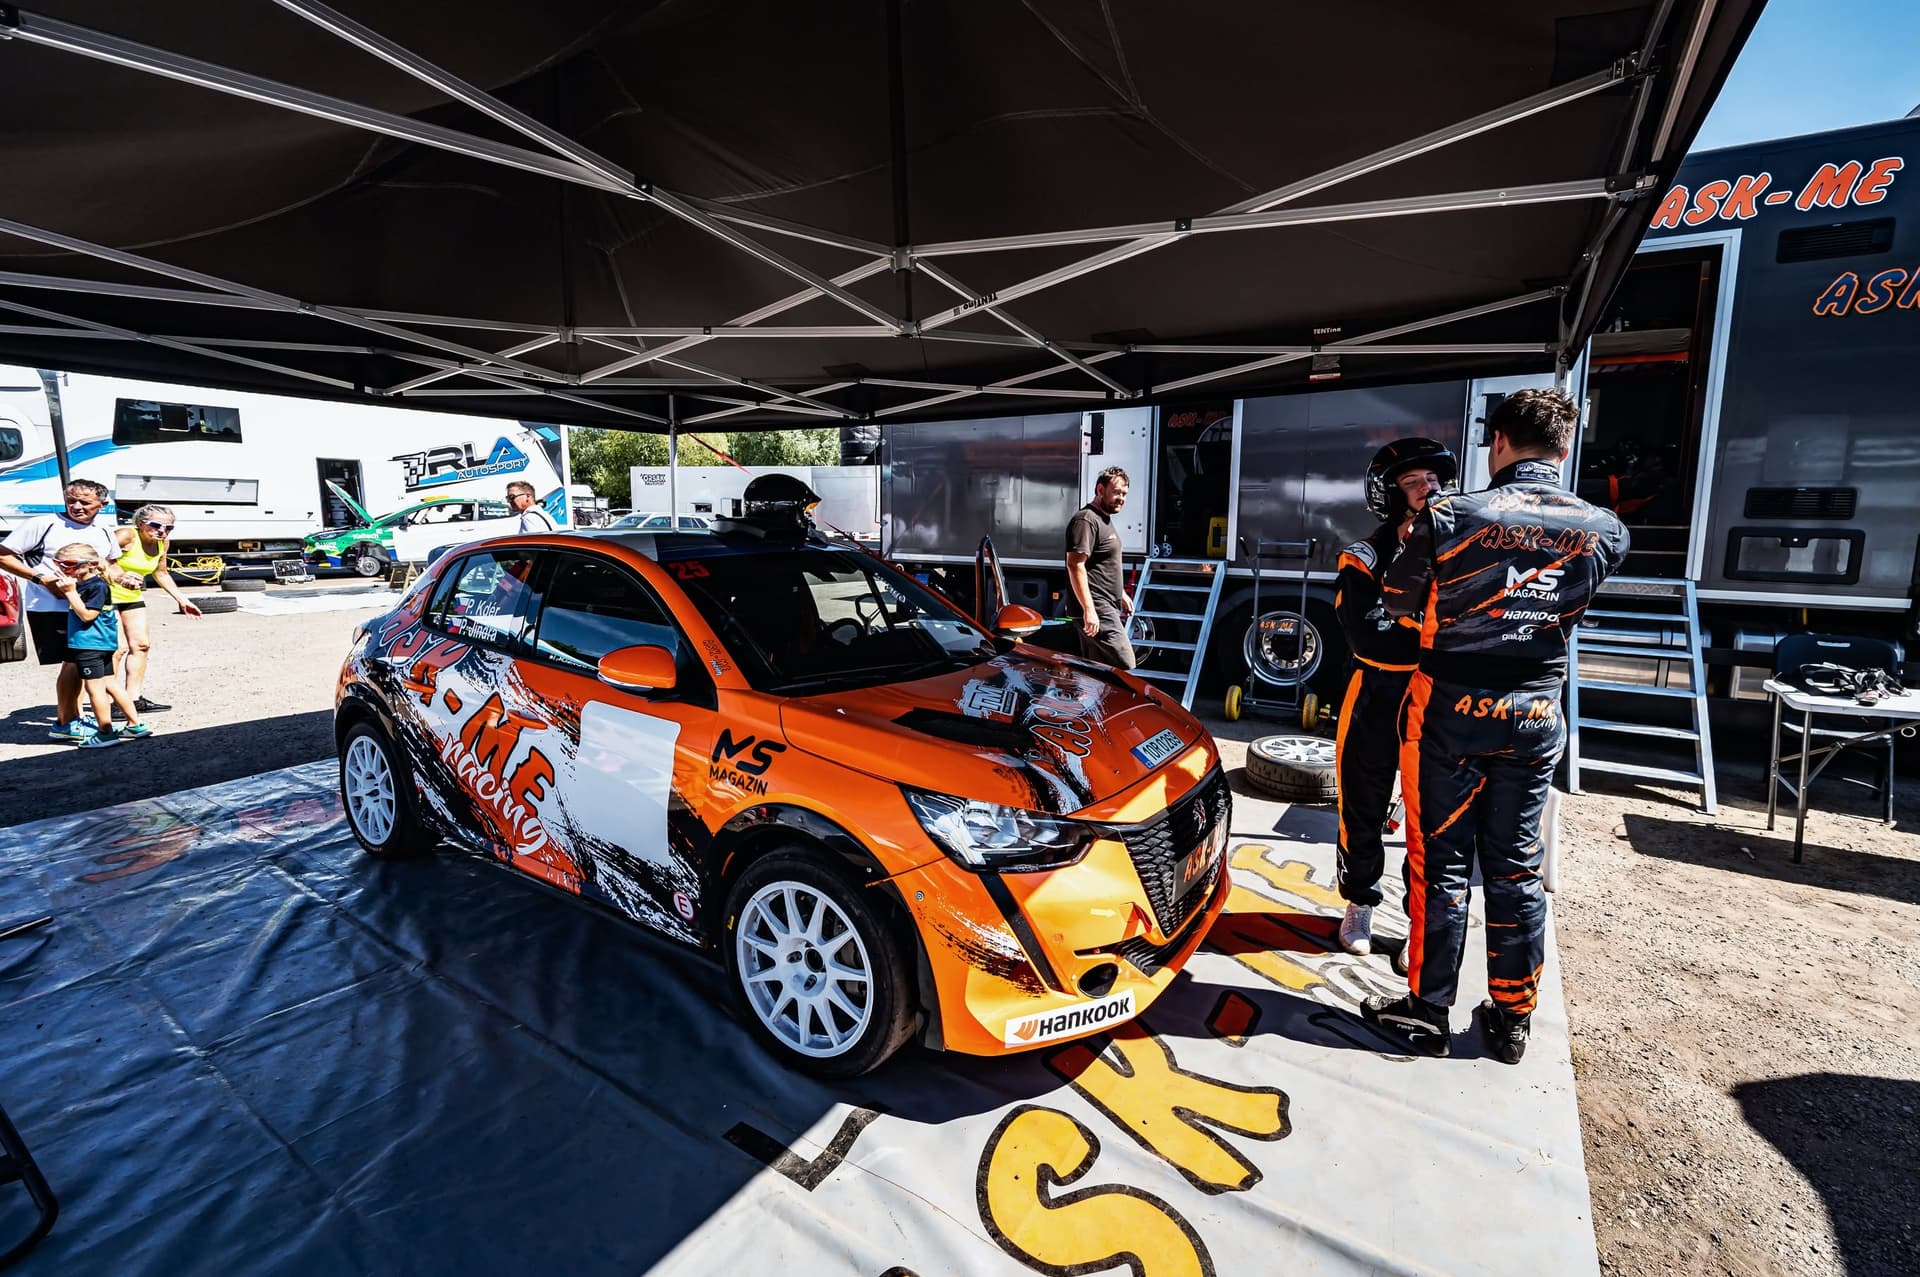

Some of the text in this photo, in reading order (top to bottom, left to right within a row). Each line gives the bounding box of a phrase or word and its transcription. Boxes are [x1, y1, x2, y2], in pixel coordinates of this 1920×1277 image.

[1650, 156, 1904, 229] ASK-ME
[457, 456, 529, 480] AUTOSPORT
[1480, 522, 1600, 556] ASK-ME
[668, 562, 710, 579] 25
[1506, 565, 1565, 591] MS
[1504, 588, 1560, 602] MAGAZIN
[712, 727, 787, 775] MS
[440, 733, 548, 856] racing
[709, 765, 768, 796] MAGAZIN
